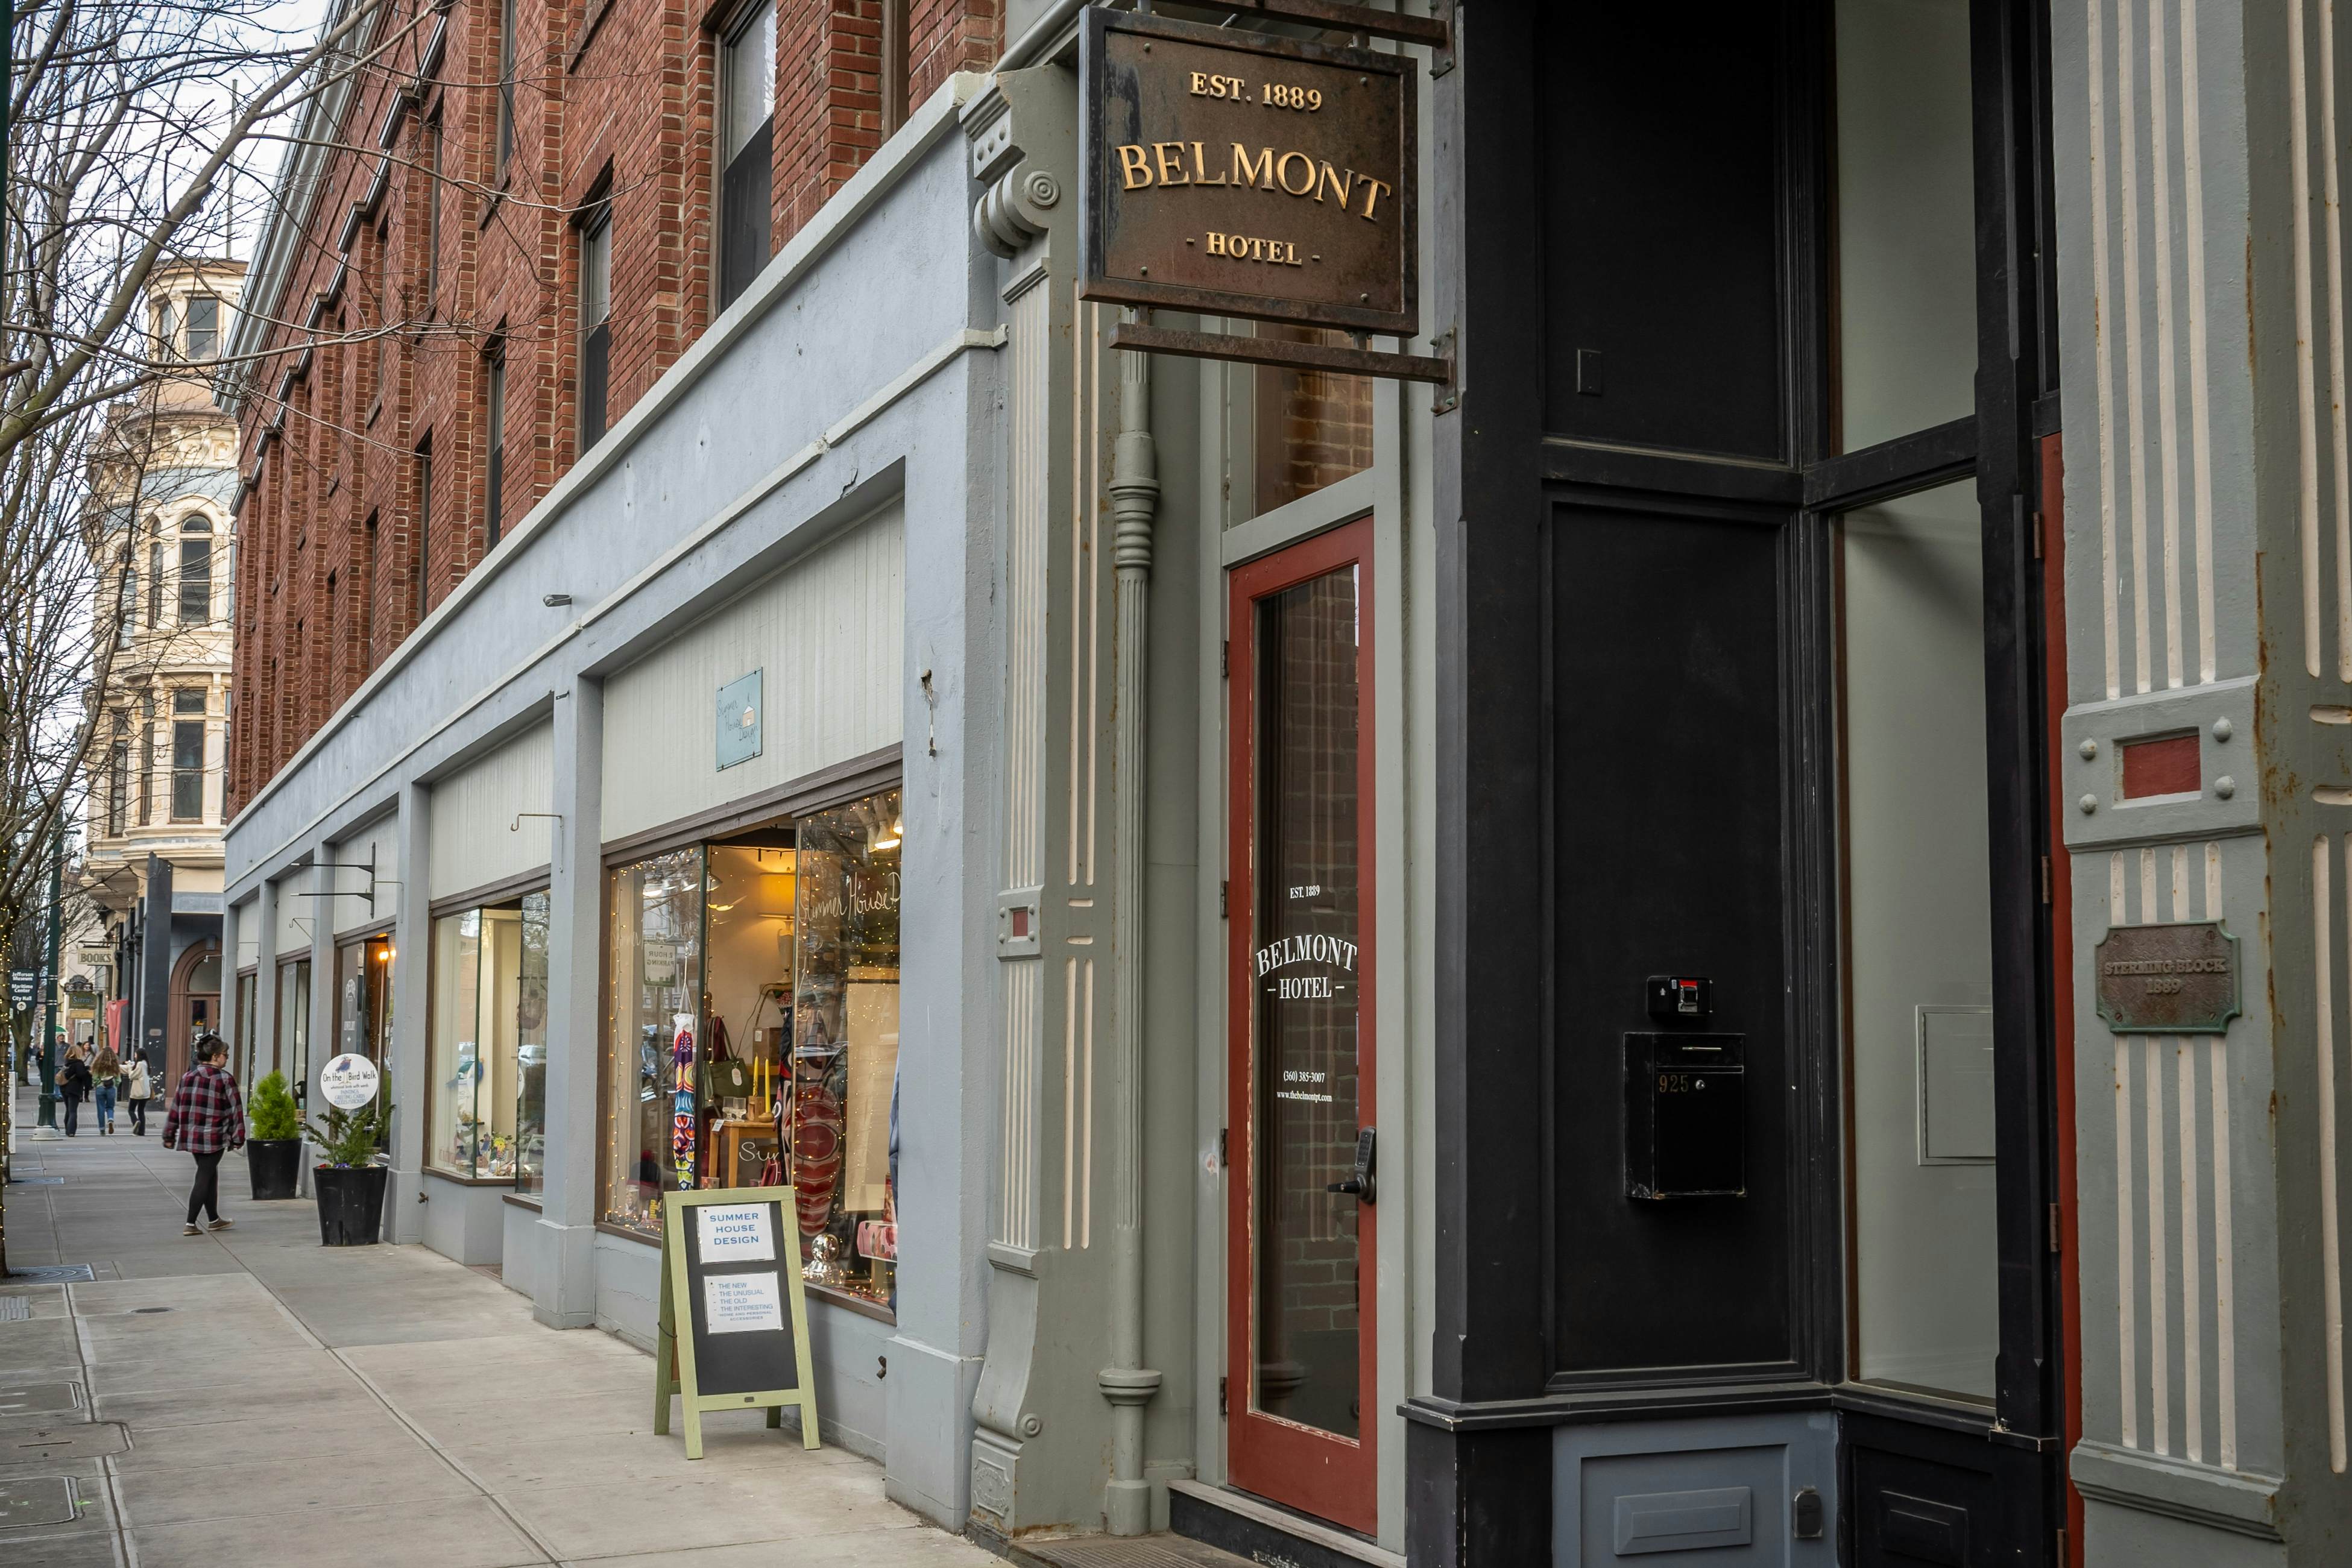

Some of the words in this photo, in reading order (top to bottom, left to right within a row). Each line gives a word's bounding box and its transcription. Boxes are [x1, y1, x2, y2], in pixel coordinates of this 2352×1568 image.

[1190, 71, 1252, 102] EST.
[1262, 83, 1322, 112] 1889
[1115, 141, 1392, 221] BELMONT
[1206, 231, 1302, 265] HOTEL
[847, 872, 892, 921] House
[1290, 886, 1304, 899] EST.
[1305, 884, 1320, 897] 1889
[80, 953, 112, 963] BOOKS
[1255, 934, 1358, 977] BELMONT
[2176, 959, 2226, 974] BLOCK
[1279, 977, 1332, 999] HOTEL
[2146, 978, 2181, 995] 1889
[323, 1073, 331, 1082] On
[332, 1072, 342, 1081] the
[348, 1071, 360, 1080] Bird
[362, 1070, 376, 1079] Walk
[1283, 1070, 1298, 1083] (360)
[1298, 1072, 1325, 1083] 385-3007
[1659, 1075, 1689, 1092] 925
[1276, 1091, 1332, 1103] www.thebelmontpt.com
[710, 1213, 759, 1223] SUMMER
[716, 1224, 756, 1233] HOUSE
[714, 1235, 759, 1245] DESIGN
